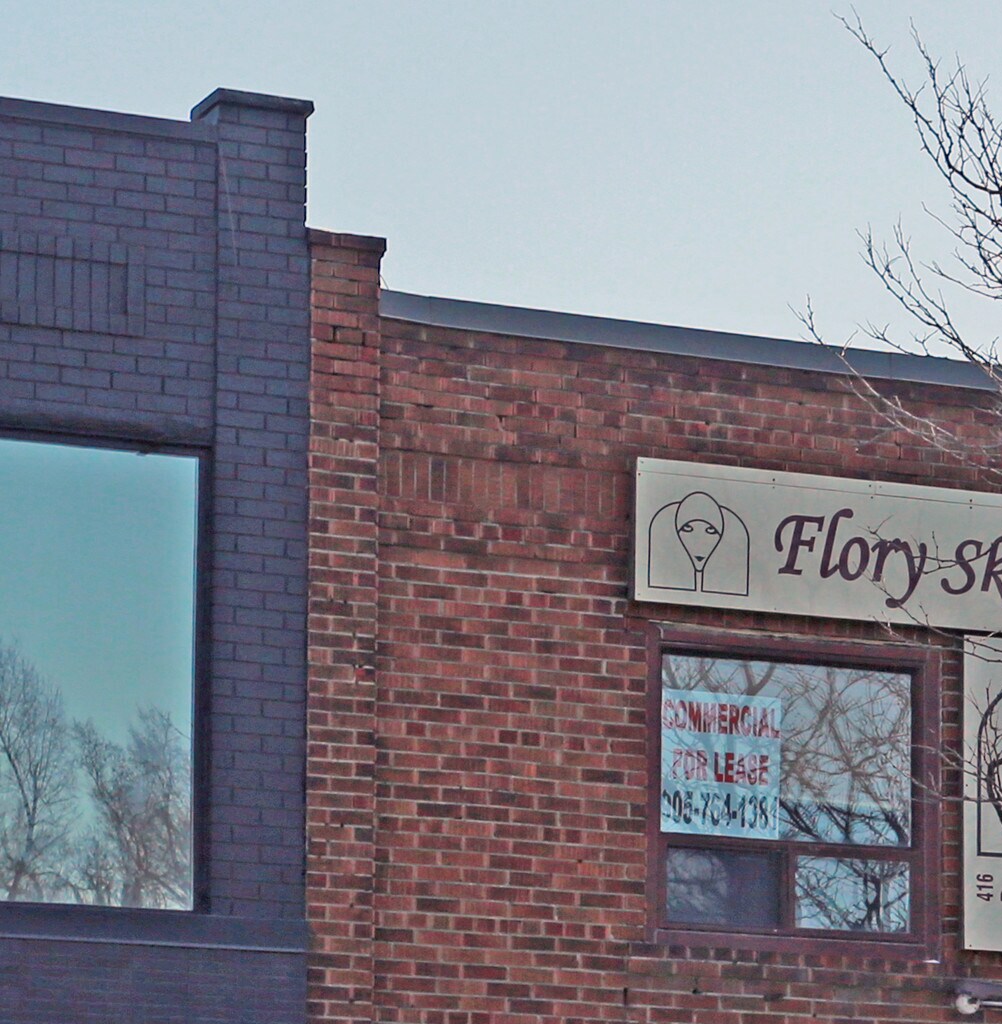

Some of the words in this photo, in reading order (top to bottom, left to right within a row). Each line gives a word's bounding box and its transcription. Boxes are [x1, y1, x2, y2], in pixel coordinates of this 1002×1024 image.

[775, 508, 927, 608] Flory
[662, 700, 781, 738] COMMERCIAL
[672, 748, 708, 781] FOR
[714, 751, 769, 786] LEASE
[977, 874, 994, 901] 416
